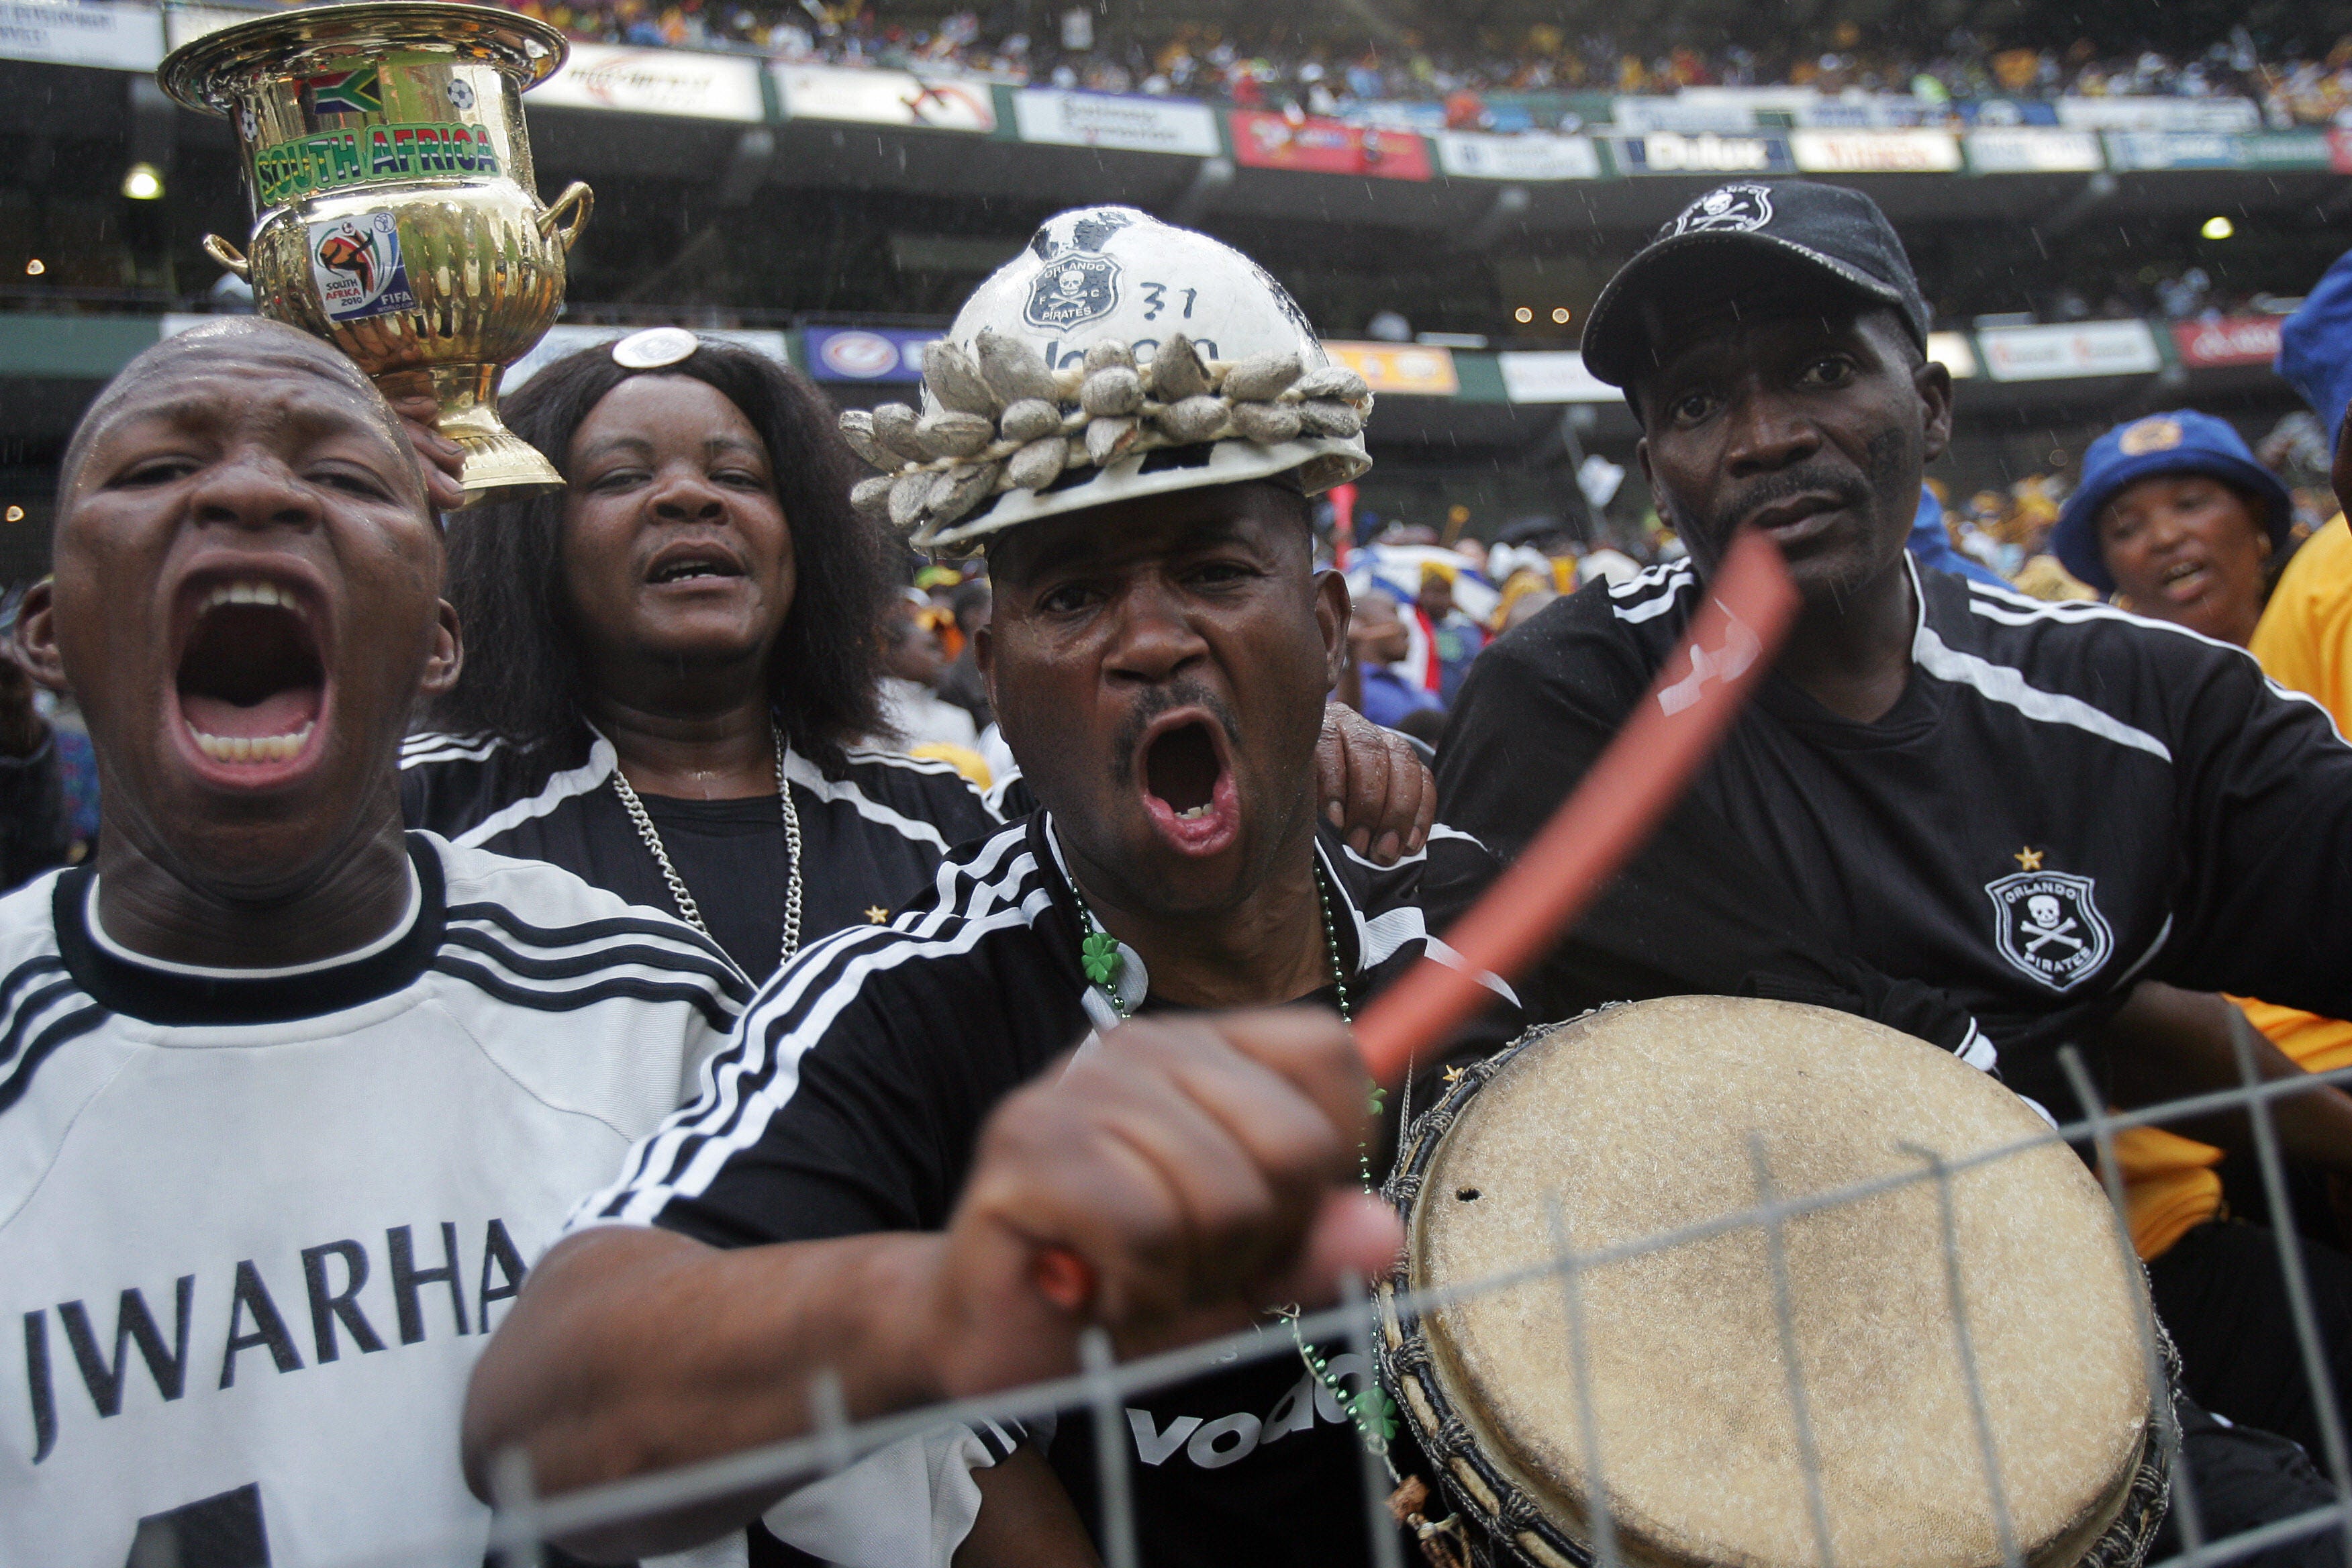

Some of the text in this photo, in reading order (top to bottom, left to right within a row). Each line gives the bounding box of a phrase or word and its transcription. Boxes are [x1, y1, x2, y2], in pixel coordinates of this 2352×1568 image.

[258, 128, 497, 199] SOUTH AFRICA
[1044, 262, 1106, 279] ORLANDO
[326, 279, 358, 291] SOUTH
[380, 291, 412, 305] FIFA
[1090, 289, 1101, 298] C
[341, 297, 363, 307] 2010
[1042, 305, 1092, 321] PIRATES
[2005, 881, 2077, 904] ORLANDO
[2024, 946, 2092, 972] PIRATES
